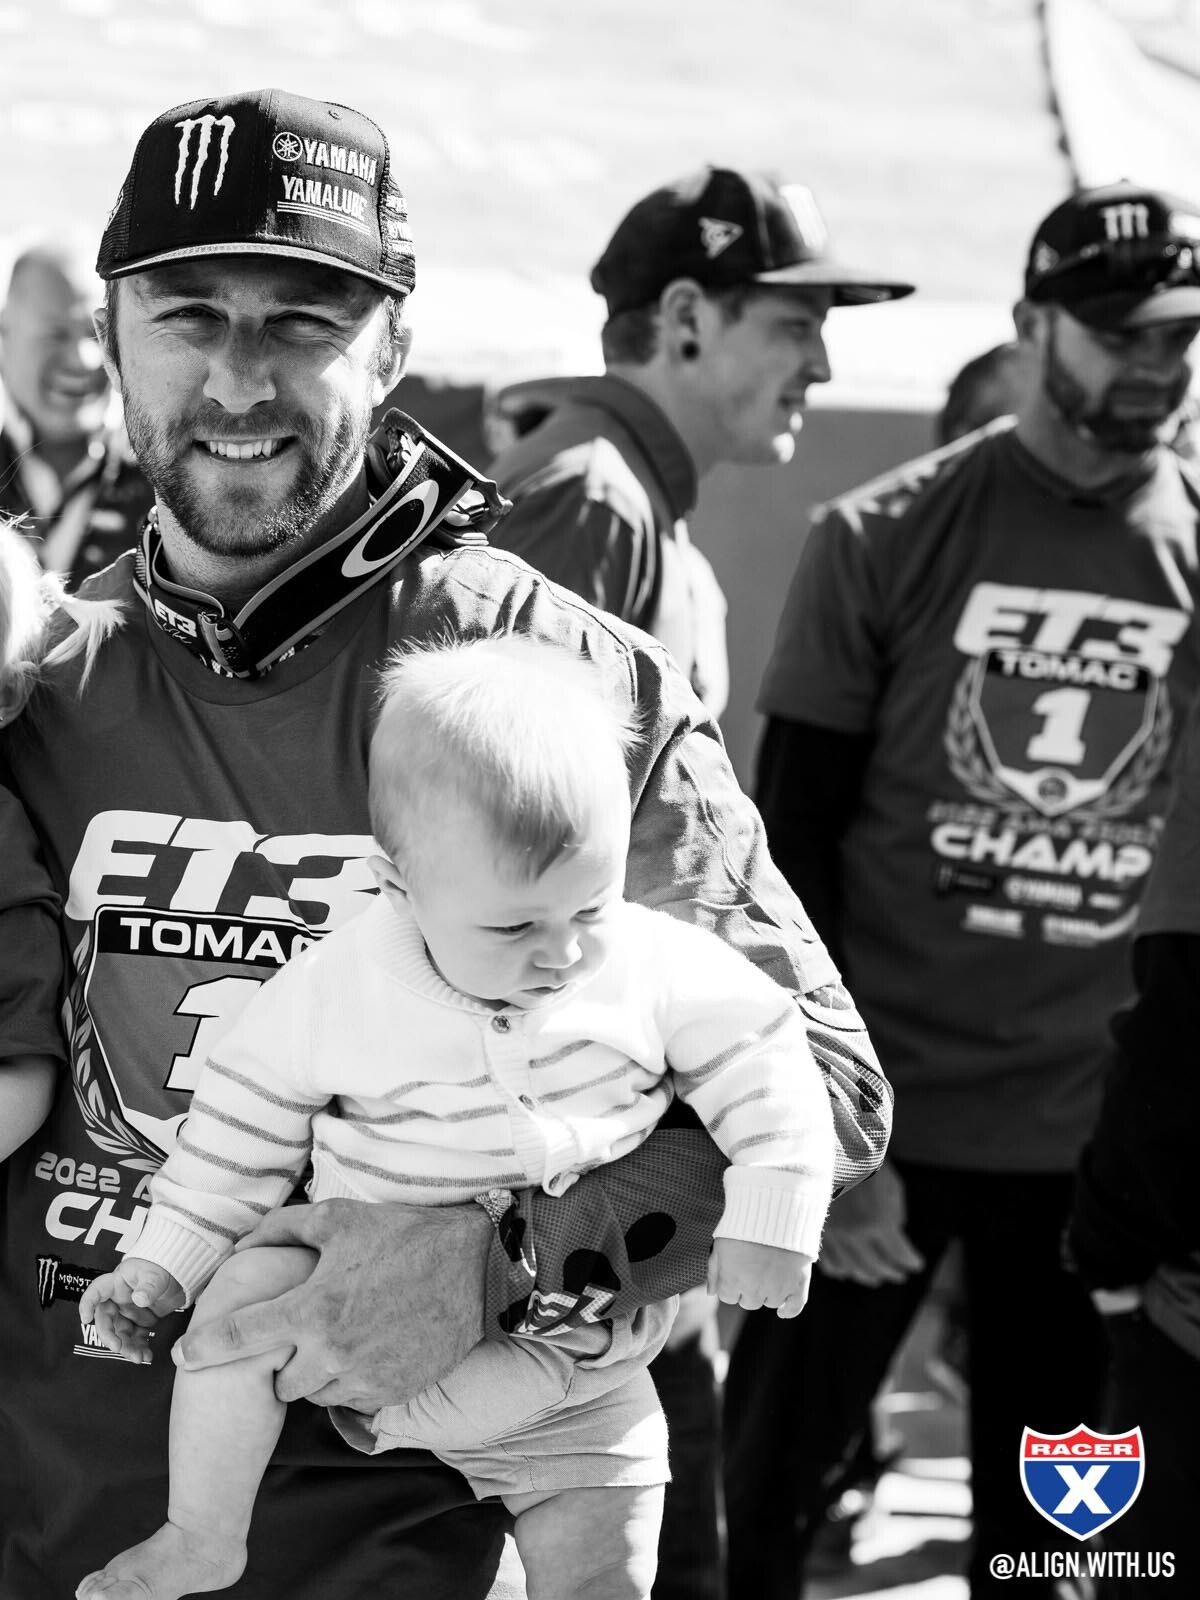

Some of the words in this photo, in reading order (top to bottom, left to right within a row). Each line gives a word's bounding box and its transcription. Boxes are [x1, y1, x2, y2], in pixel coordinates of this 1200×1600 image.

[303, 138, 377, 186] YAMAHA
[154, 598, 198, 638] ET3
[953, 581, 1190, 678] ET3
[998, 651, 1140, 690] TOMAC
[1026, 686, 1091, 766] 1
[930, 822, 1153, 883] CHAMP
[35, 1151, 121, 1194] 2022
[59, 1273, 91, 1287] MONST
